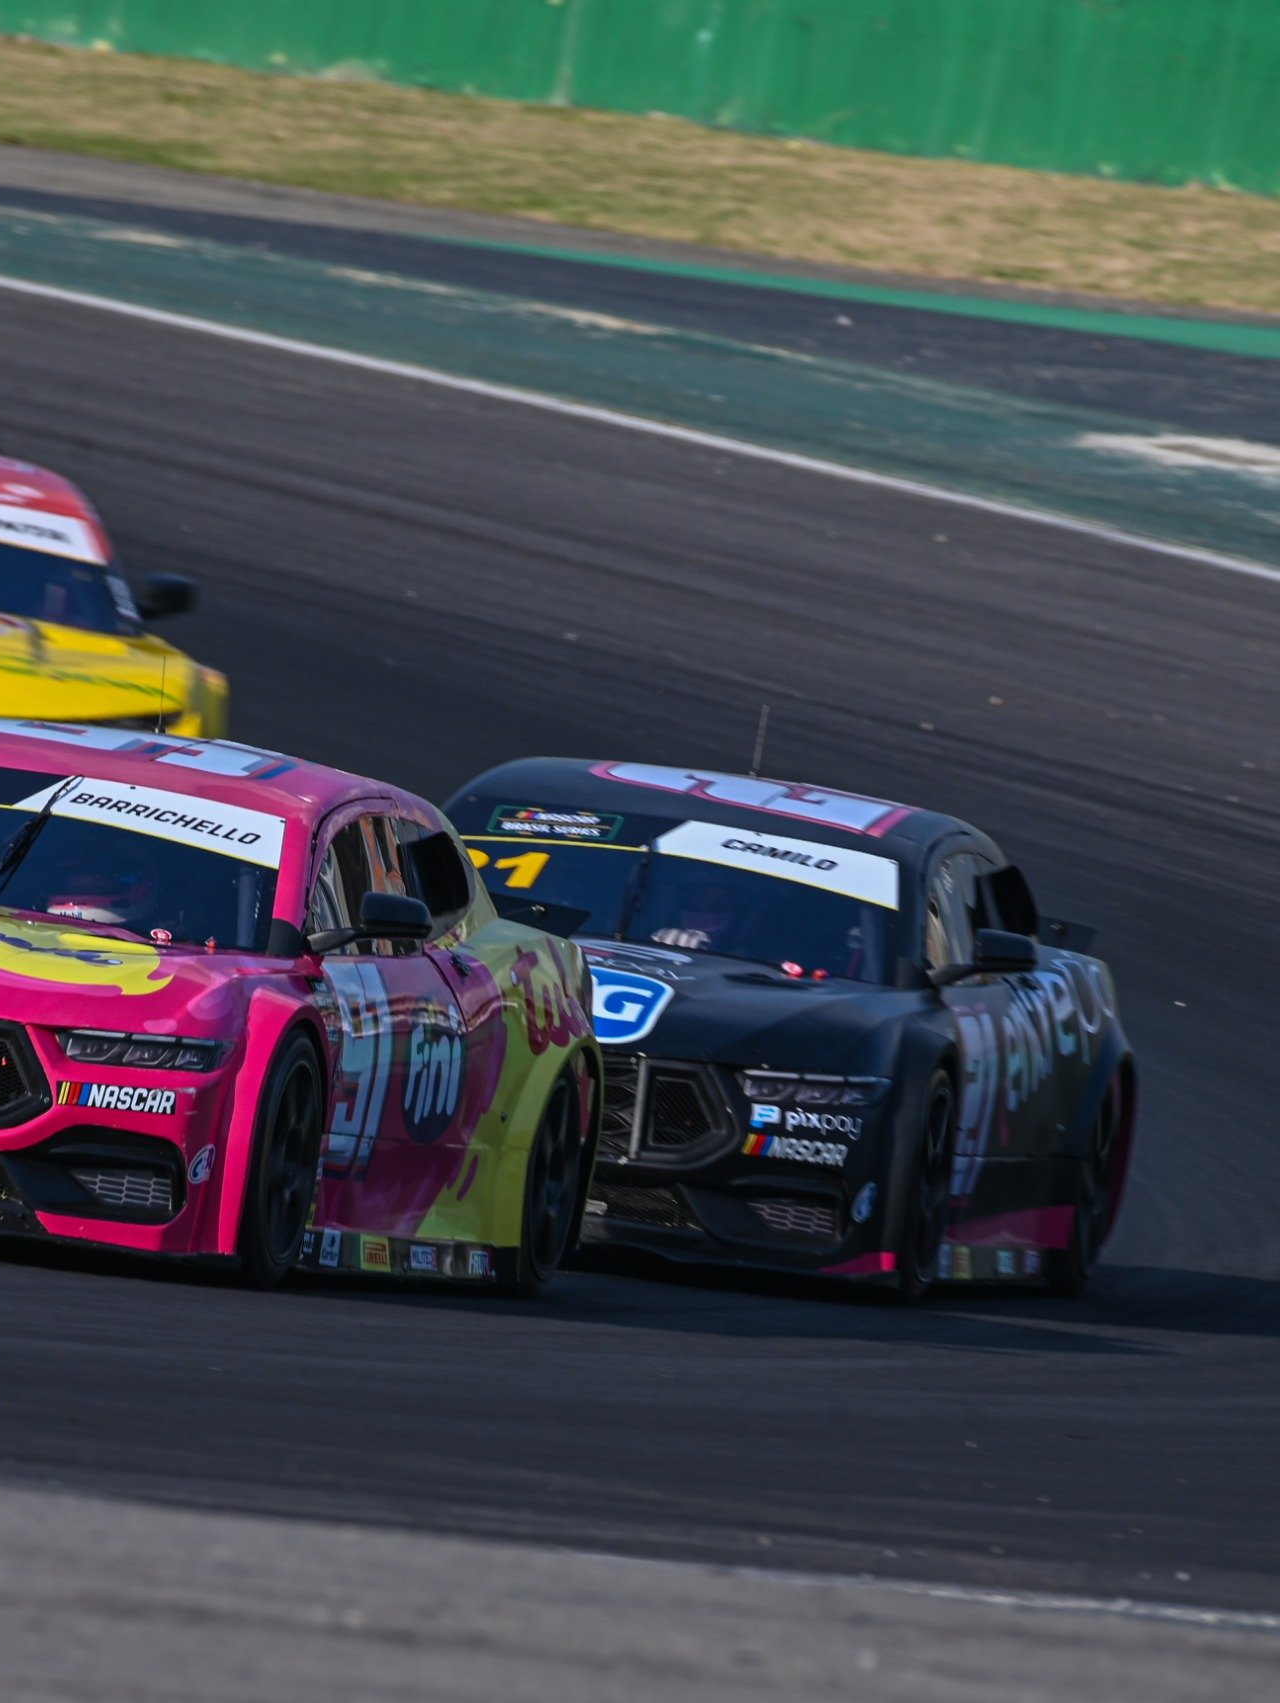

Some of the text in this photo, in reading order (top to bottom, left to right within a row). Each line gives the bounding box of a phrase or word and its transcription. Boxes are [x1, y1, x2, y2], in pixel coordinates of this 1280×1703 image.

[69, 793, 261, 845] BARRICHELLO
[720, 838, 838, 872] CAMILO
[87, 1083, 175, 1115] NASCAR
[785, 1107, 863, 1141] pixpay
[767, 1135, 848, 1167] NASCAR
